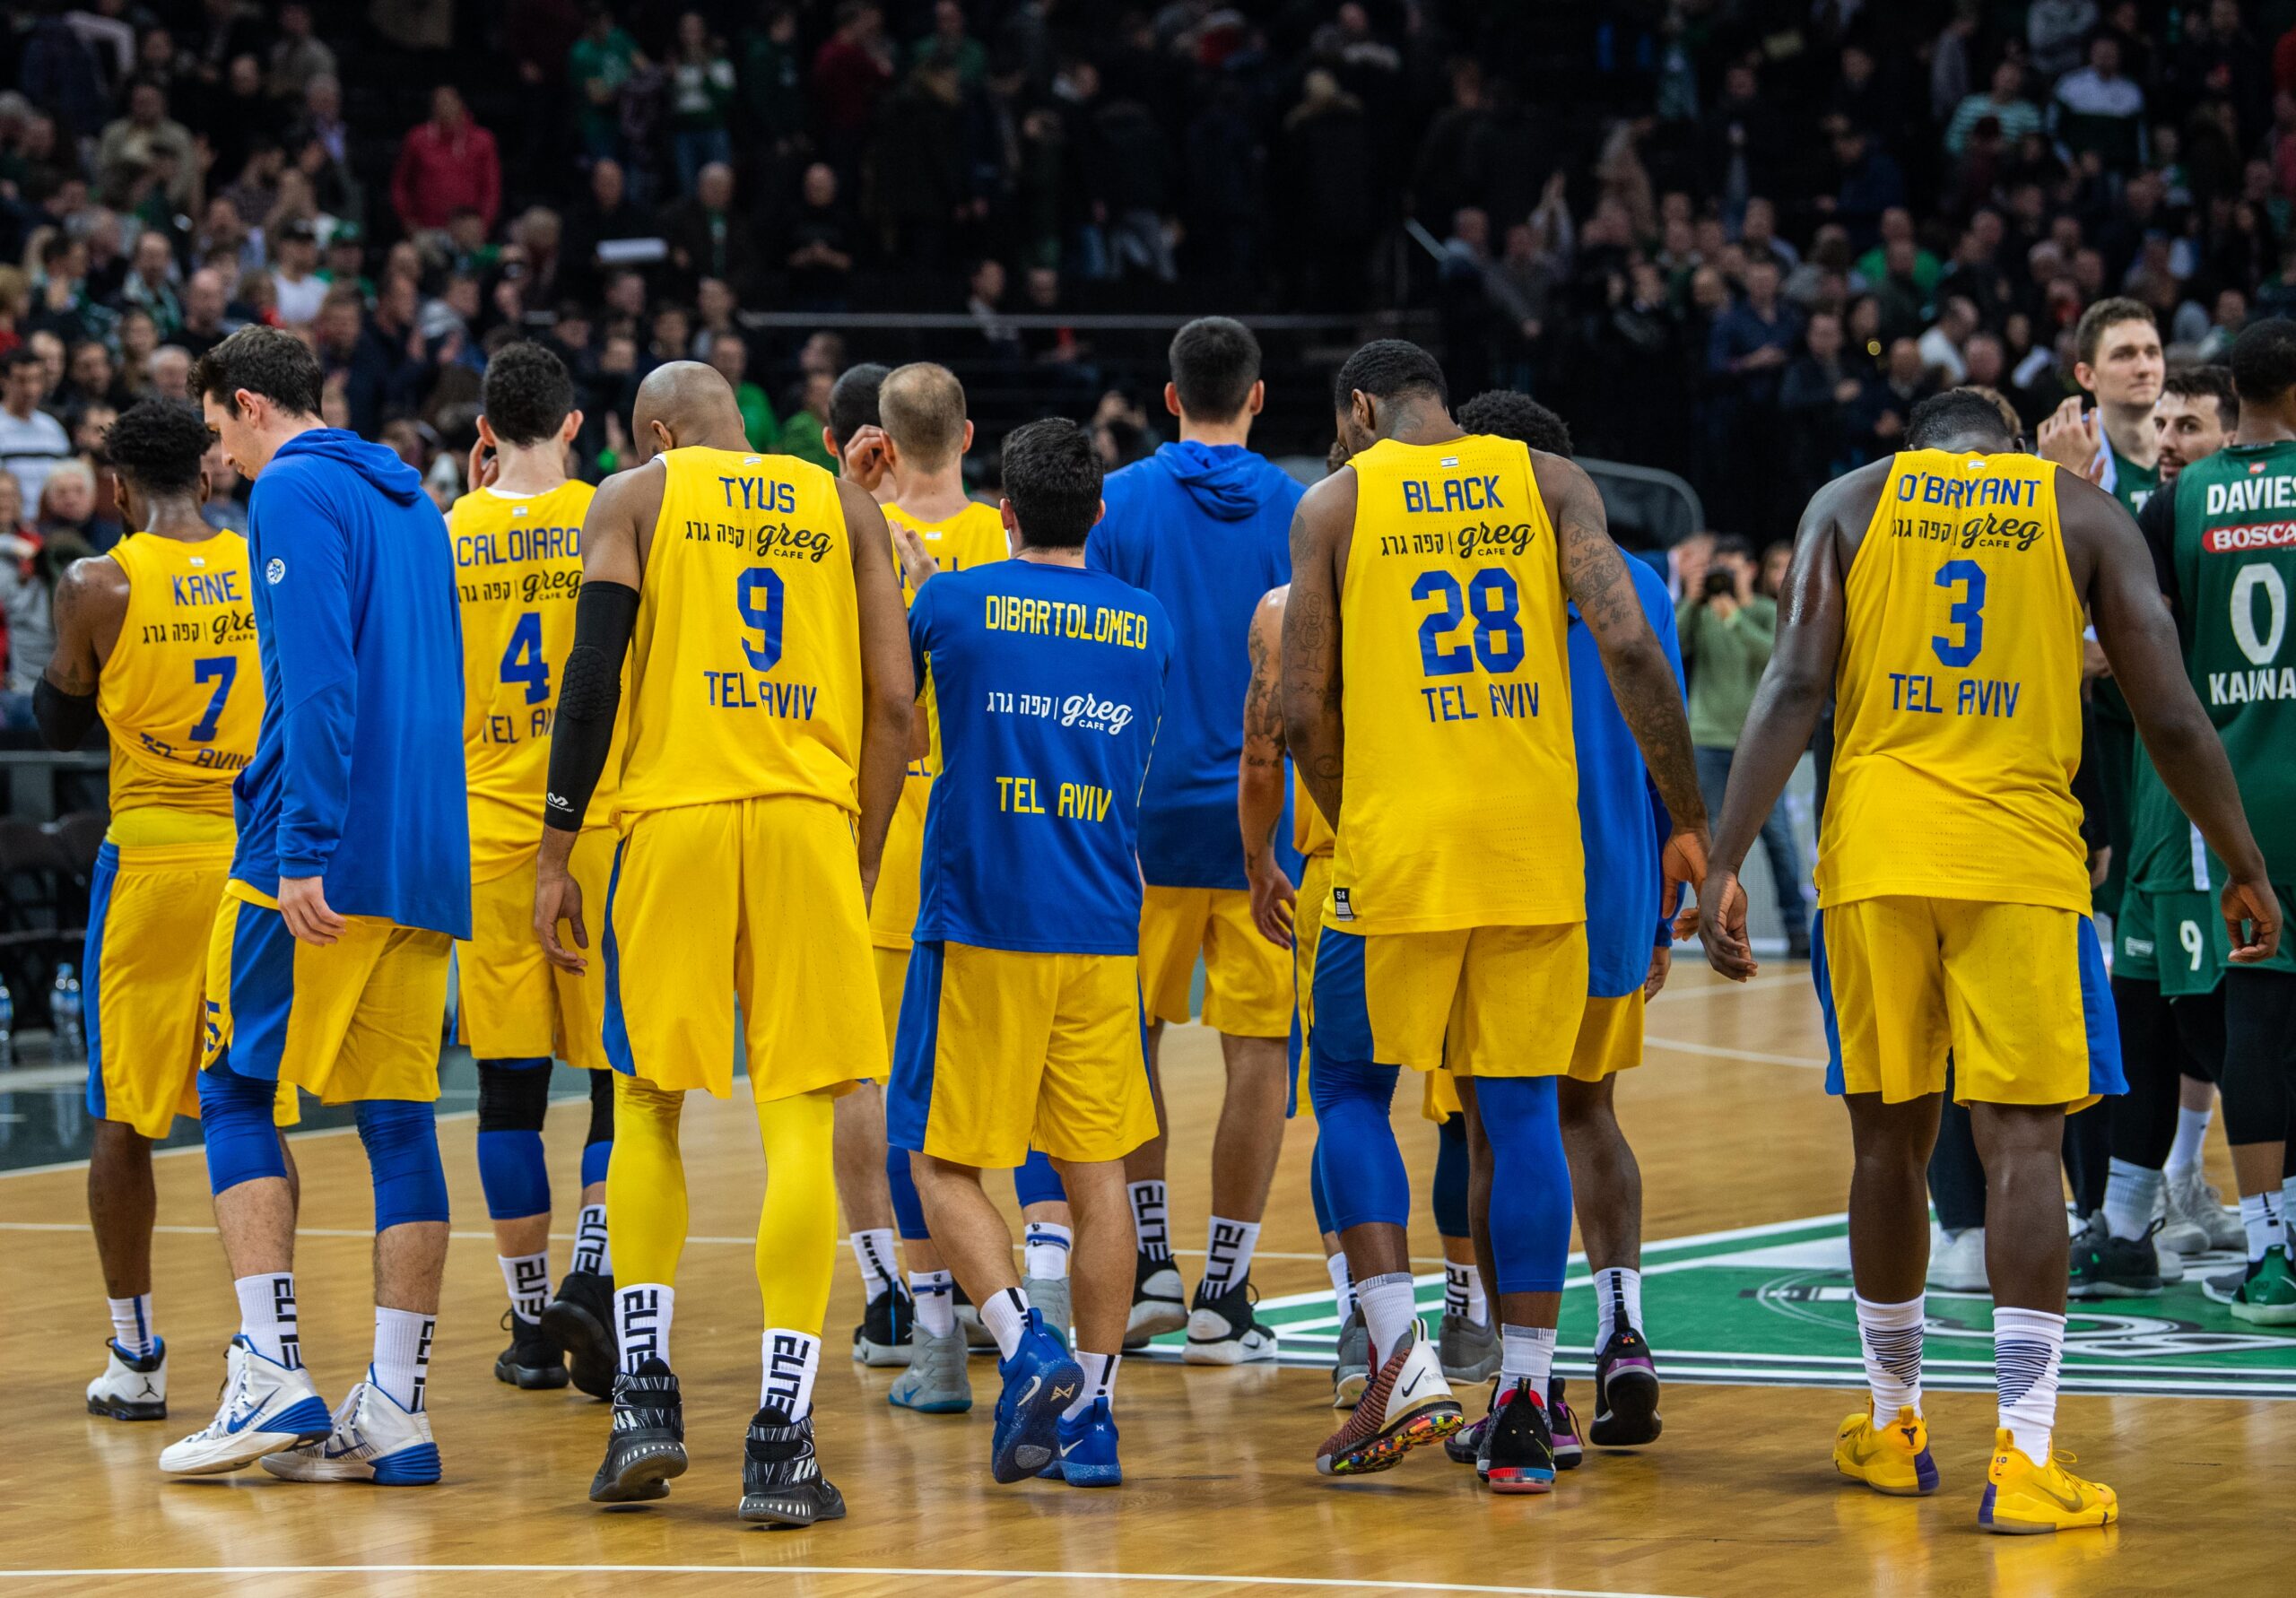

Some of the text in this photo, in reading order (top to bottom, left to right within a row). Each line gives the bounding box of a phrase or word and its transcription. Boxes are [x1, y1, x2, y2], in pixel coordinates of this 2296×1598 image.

[718, 475, 796, 514] TYUS
[1402, 474, 1505, 513] BLACK
[1897, 472, 2042, 509] O'BRYANT
[2206, 475, 2296, 516] DAVIE
[457, 527, 581, 567] CALOIARO
[685, 520, 745, 550] קפה גרג
[756, 522, 833, 563] greg
[1380, 532, 1445, 556] קפה גרג
[1457, 521, 1535, 560] greg
[1477, 546, 1506, 556] CAFE
[1961, 512, 2045, 551] greg
[1979, 539, 2010, 548] CAFE
[773, 548, 804, 560] CAFE
[171, 570, 243, 606] KANE
[522, 569, 584, 603] greg
[538, 591, 561, 601] CAFE
[212, 610, 257, 645] gre
[736, 566, 785, 673] 9
[985, 595, 1148, 650] DIBARTOLOMEO
[1411, 567, 1526, 677] 28
[1931, 559, 1987, 668] 3
[2230, 561, 2287, 665] 0
[228, 633, 256, 642] CAFE
[500, 612, 550, 705] 4
[188, 656, 238, 743] 7
[703, 671, 817, 721] TEL AVIV
[986, 691, 1051, 718] קפה גרג
[1060, 692, 1134, 735] greg
[1421, 682, 1539, 723] TEL AVIV
[1889, 673, 2021, 718] TEL AVIV
[1078, 719, 1105, 731] CAFE
[996, 777, 1113, 823] TEL AVIV
[1336, 890, 1346, 900] 54
[2179, 920, 2204, 971] 9
[764, 1334, 811, 1419] ELITE
